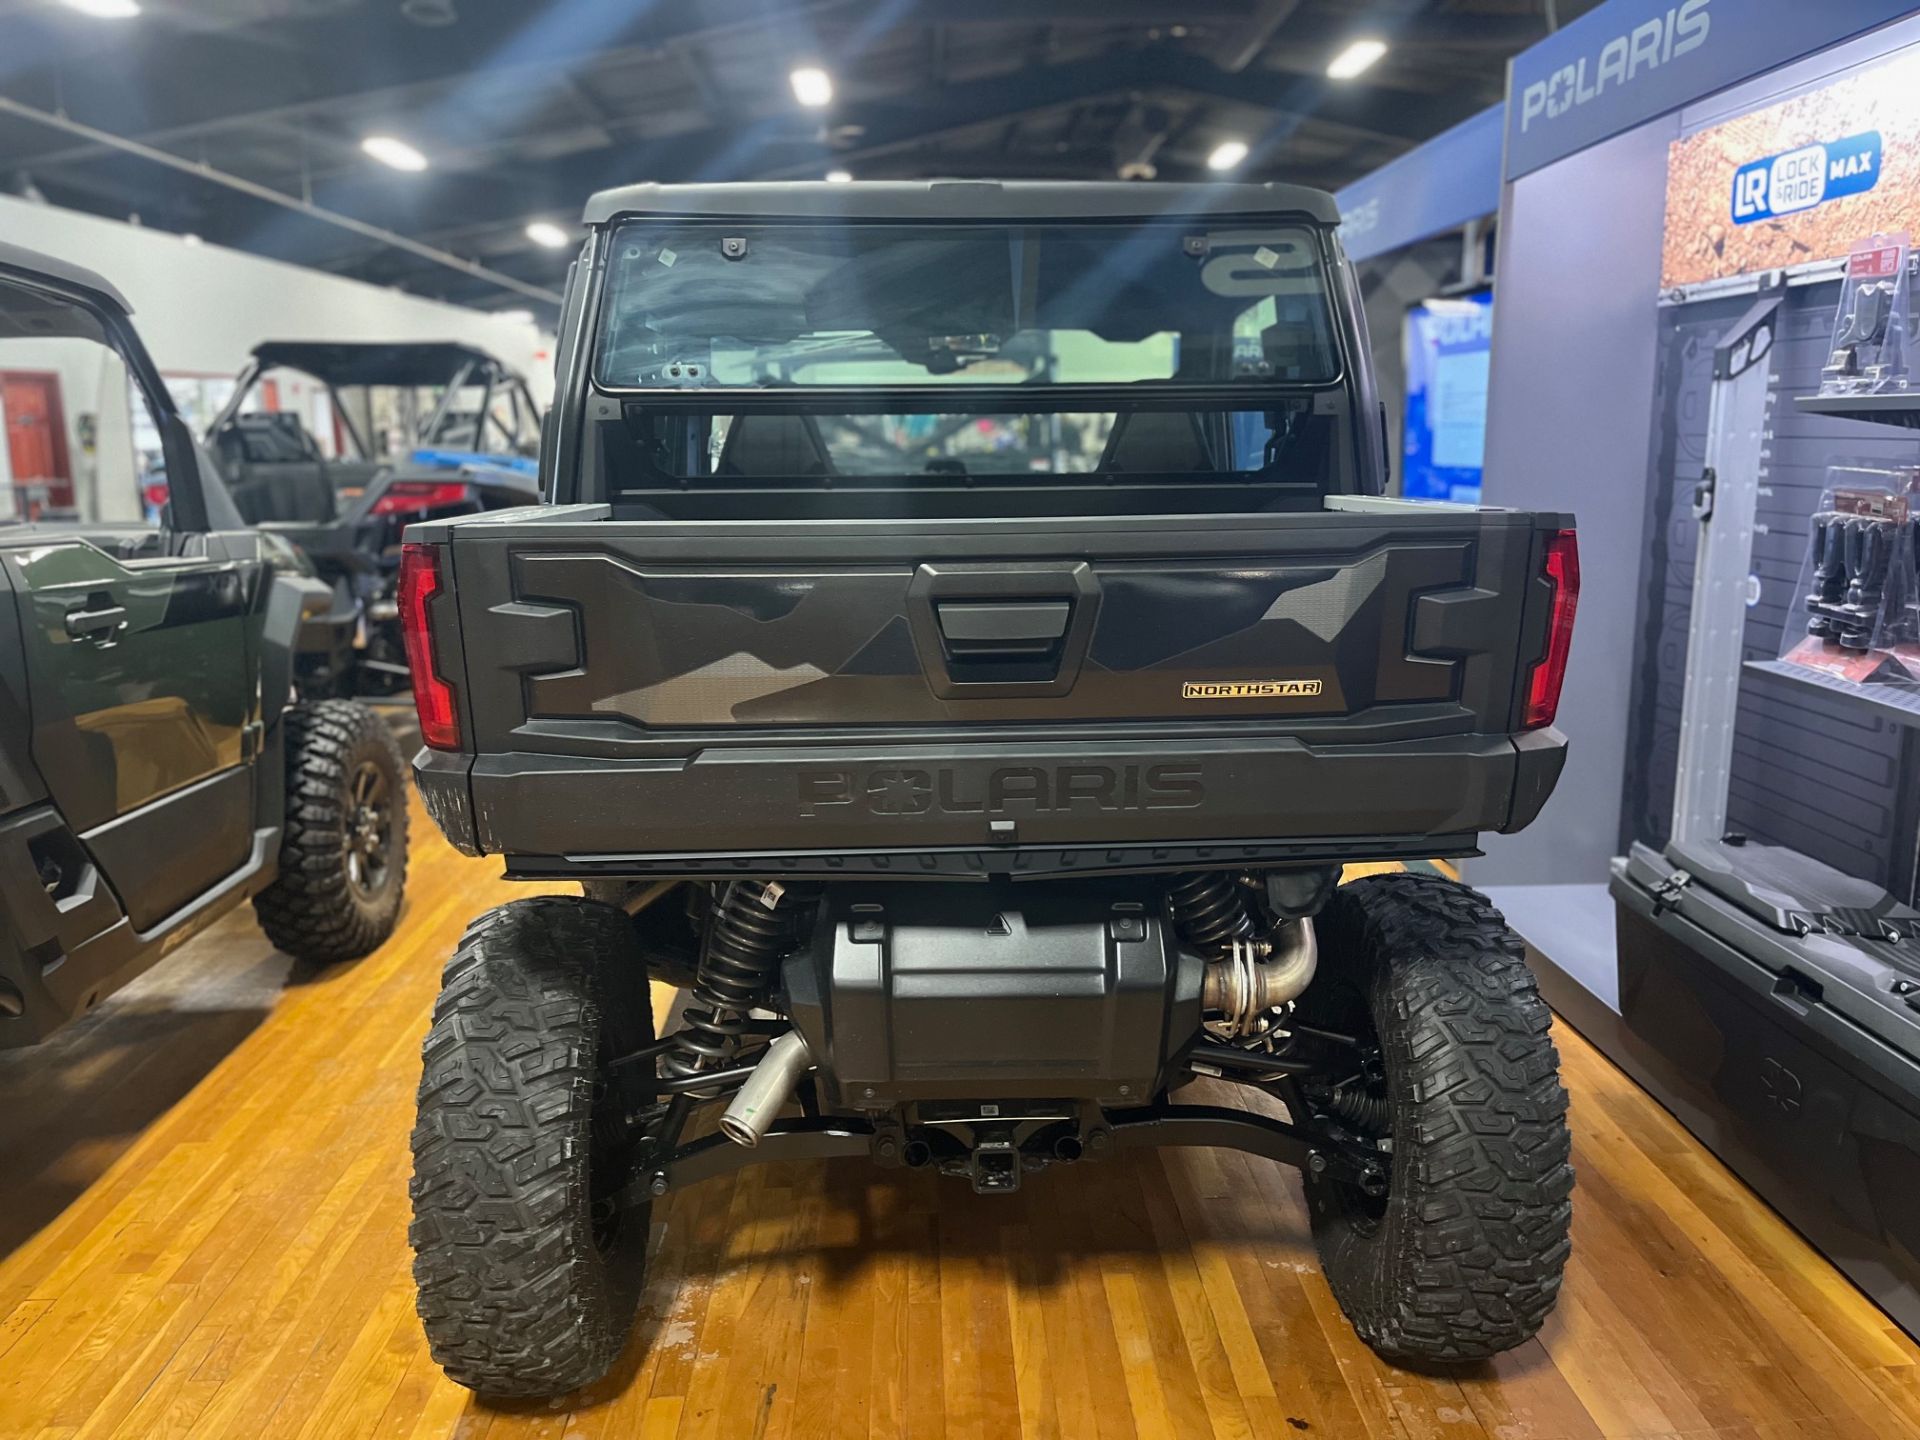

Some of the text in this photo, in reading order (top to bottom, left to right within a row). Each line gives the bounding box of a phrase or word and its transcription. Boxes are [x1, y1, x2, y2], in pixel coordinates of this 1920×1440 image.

[1521, 0, 1711, 133] POLARIS
[1776, 153, 1820, 183] LOCK
[1829, 150, 1873, 181] MAX
[1734, 167, 1768, 218] LR
[1188, 682, 1317, 696] NORTHSTAR
[799, 764, 1203, 817] POLARIS
